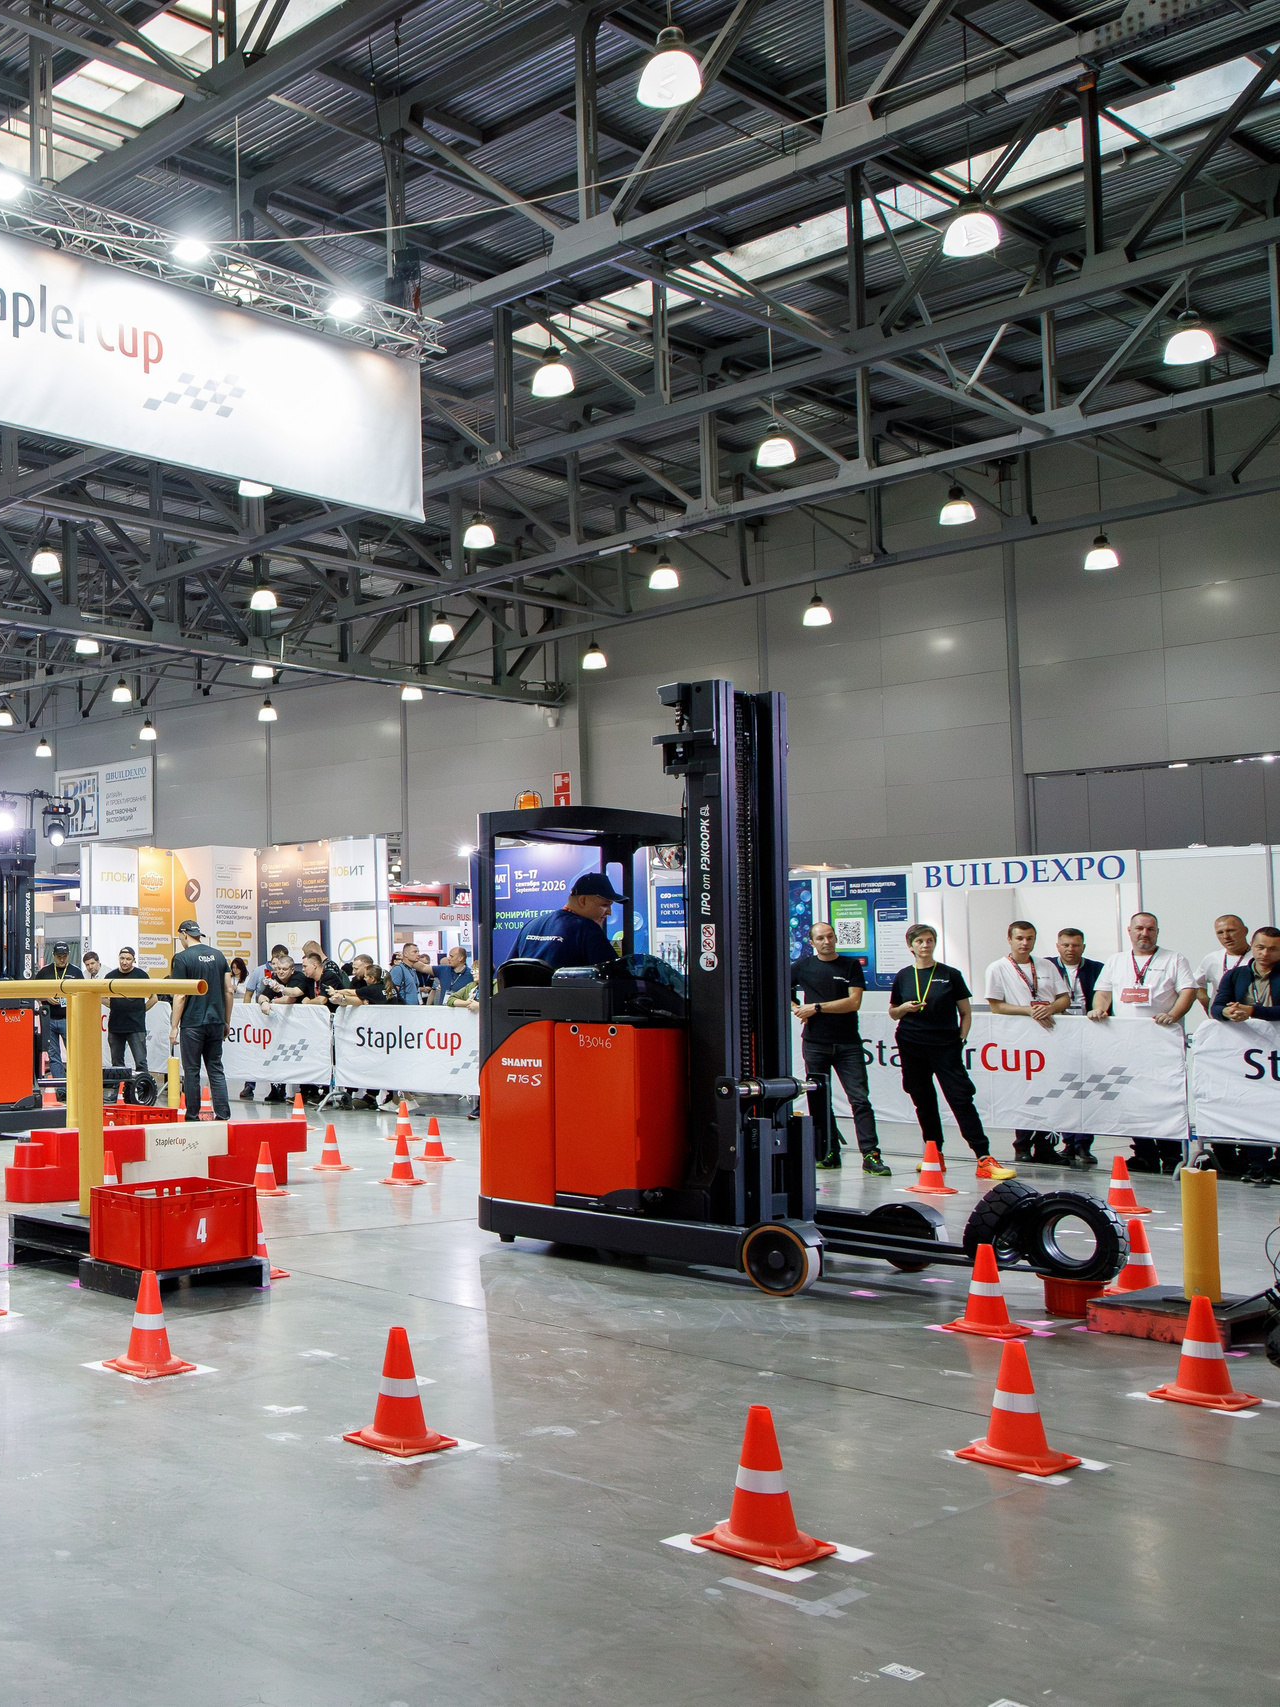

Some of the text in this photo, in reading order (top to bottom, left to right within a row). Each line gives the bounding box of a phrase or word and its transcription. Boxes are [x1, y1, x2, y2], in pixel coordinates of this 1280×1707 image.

[110, 766, 147, 780] BUILDEXPO
[110, 794, 147, 805] ПРОЕКТИРОВАНИЕ
[106, 806, 137, 816] ВЫСТАВОЧНЫХ
[106, 814, 133, 823] ЭКСПОЗИЦИЙ
[700, 818, 711, 916] ПРО от РЭКФОРК
[923, 855, 1126, 888] BUILDEXPO
[100, 871, 135, 883] ГЛОБИТ
[515, 886, 540, 894] September
[541, 880, 566, 892] 2026
[215, 887, 253, 899] ГЛОБИТ
[440, 912, 455, 921] iGrip
[356, 1025, 462, 1056] StaplerCup
[578, 1034, 612, 1049] B3046
[501, 1057, 543, 1068] SHANTUI
[155, 1136, 187, 1147] StaplerCup
[196, 1217, 208, 1243] 4
